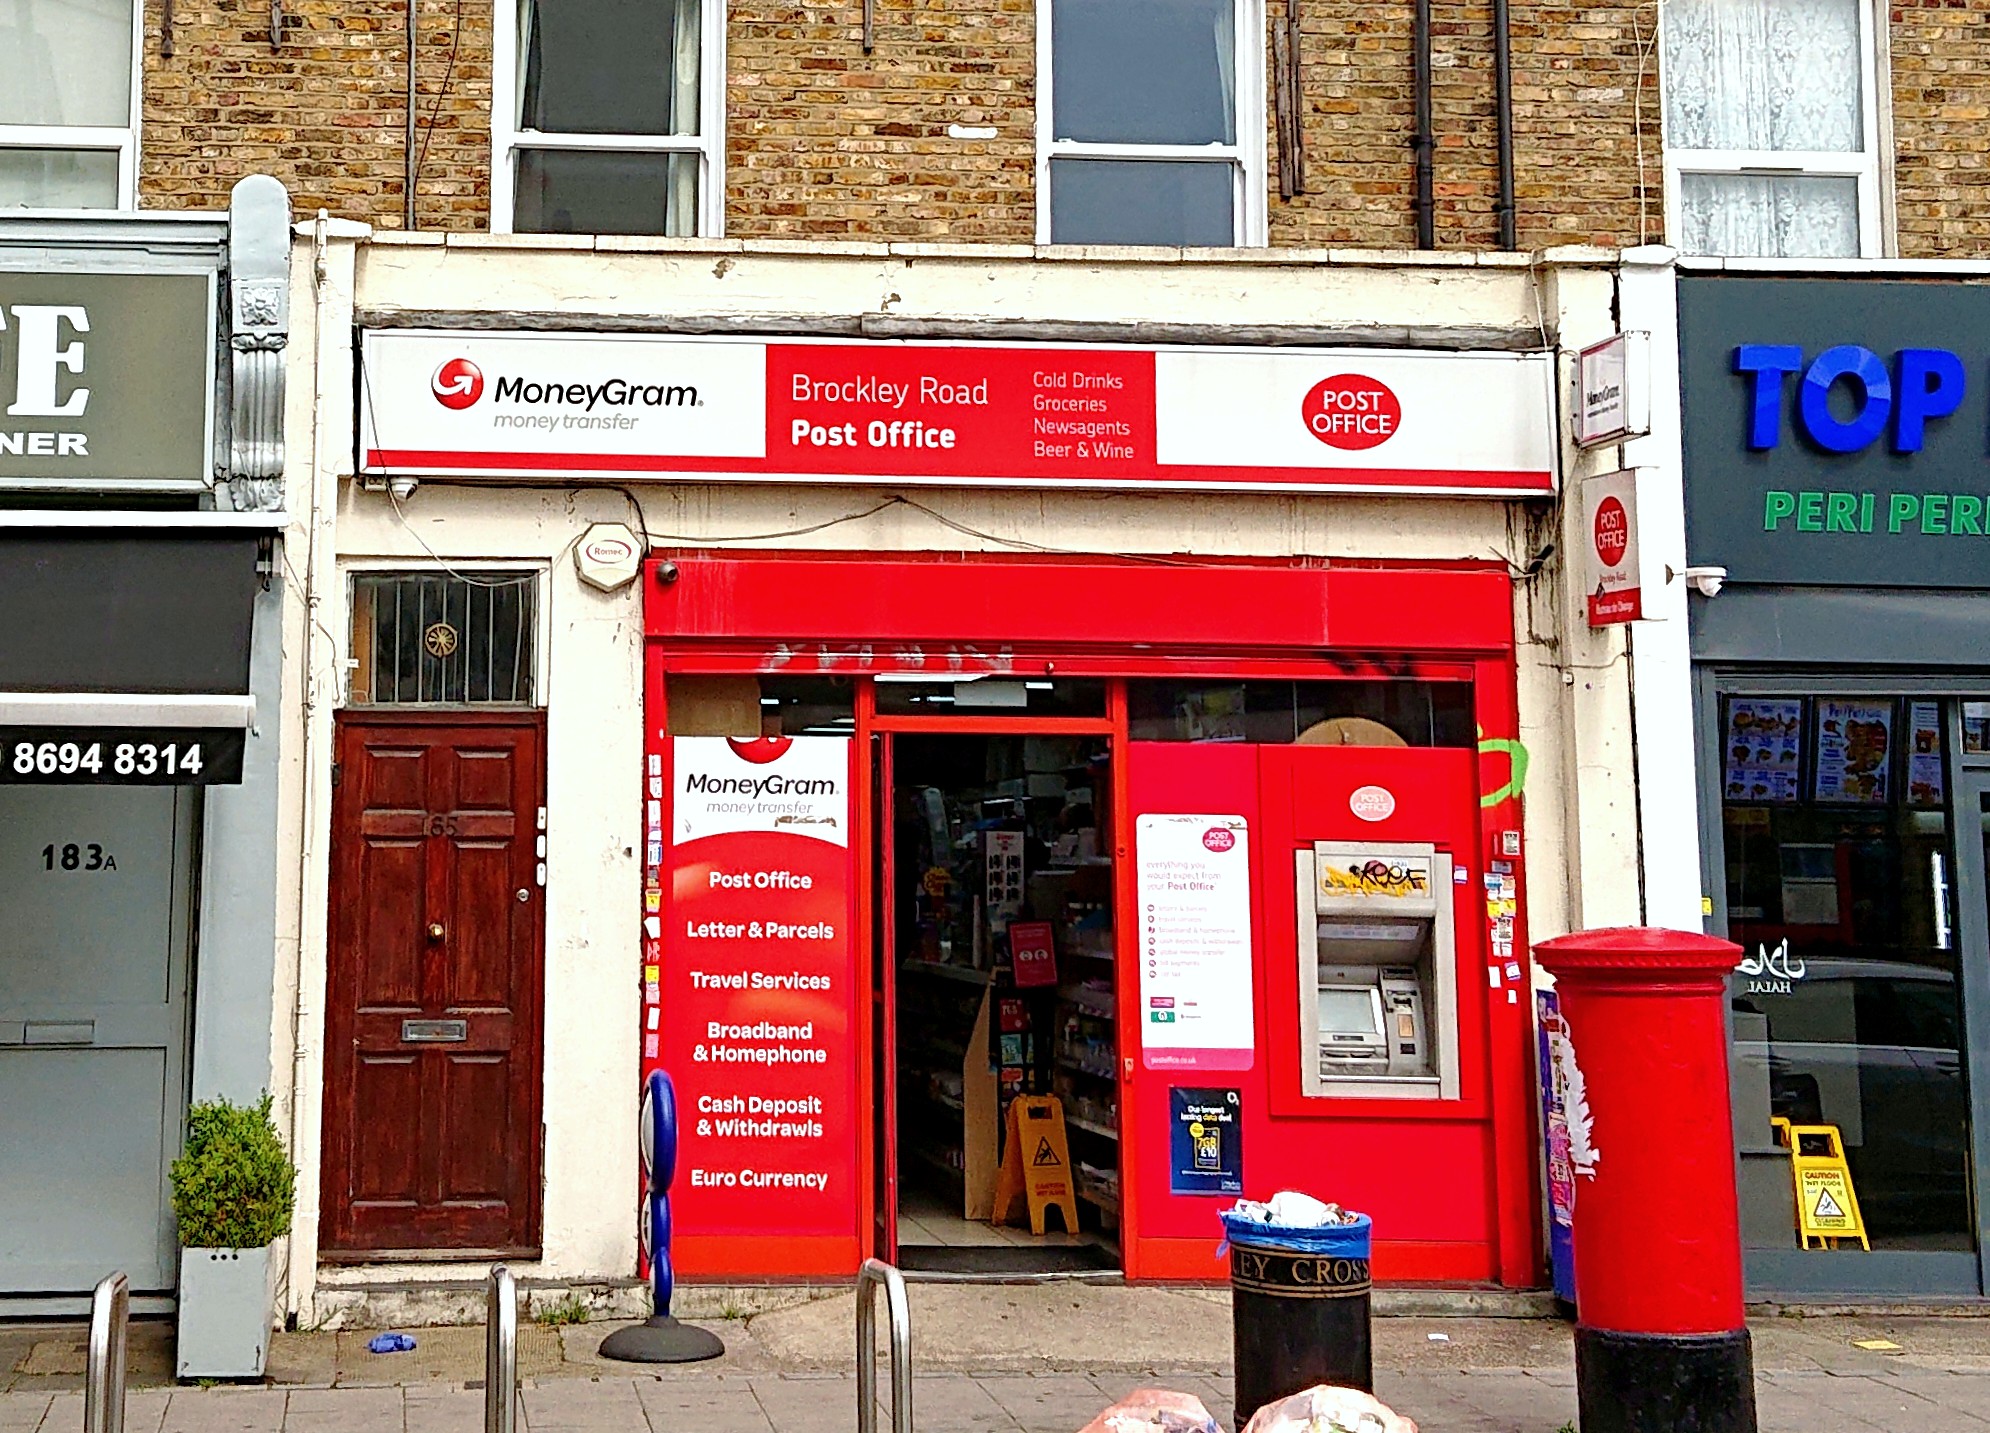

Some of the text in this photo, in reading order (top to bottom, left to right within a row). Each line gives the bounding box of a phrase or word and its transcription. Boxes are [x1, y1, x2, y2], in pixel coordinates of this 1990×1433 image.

[0, 305, 90, 416] E
[1033, 371, 1123, 389] Cold Drinks
[792, 373, 989, 409] Brockley Road
[1323, 390, 1384, 411] POST
[1732, 344, 1965, 452] TOP
[1033, 394, 1107, 412] Groceries
[493, 413, 639, 433] money transfer
[1034, 417, 1131, 438] Newsagents
[1312, 413, 1392, 434] OFFICE
[791, 419, 956, 449] Post Office
[1034, 440, 1135, 459] Beer & Wine
[1601, 509, 1621, 530] POST
[1764, 491, 1876, 533] PERI
[1597, 529, 1625, 550] OFFICE
[13, 742, 203, 775] 8694 8314
[1361, 793, 1385, 803] POST
[706, 801, 814, 815] money transfer
[1356, 803, 1389, 813] OFFICE
[1205, 839, 1232, 848] OFFICE
[1208, 831, 1230, 840] POST
[709, 871, 813, 889] Post Office
[1168, 881, 1187, 890] Post
[687, 920, 834, 939] Letter & Parcels
[690, 971, 831, 990] Travel Services
[707, 1021, 813, 1040] Broadband
[693, 1044, 827, 1067] & Homephone
[697, 1095, 822, 1118] Cash Deposit
[696, 1118, 823, 1137] & Withdrawls
[1197, 1136, 1217, 1149] 7GB
[1200, 1147, 1217, 1157] £10
[691, 1169, 828, 1191] Euro Currency
[1292, 1259, 1369, 1283] CROSS
